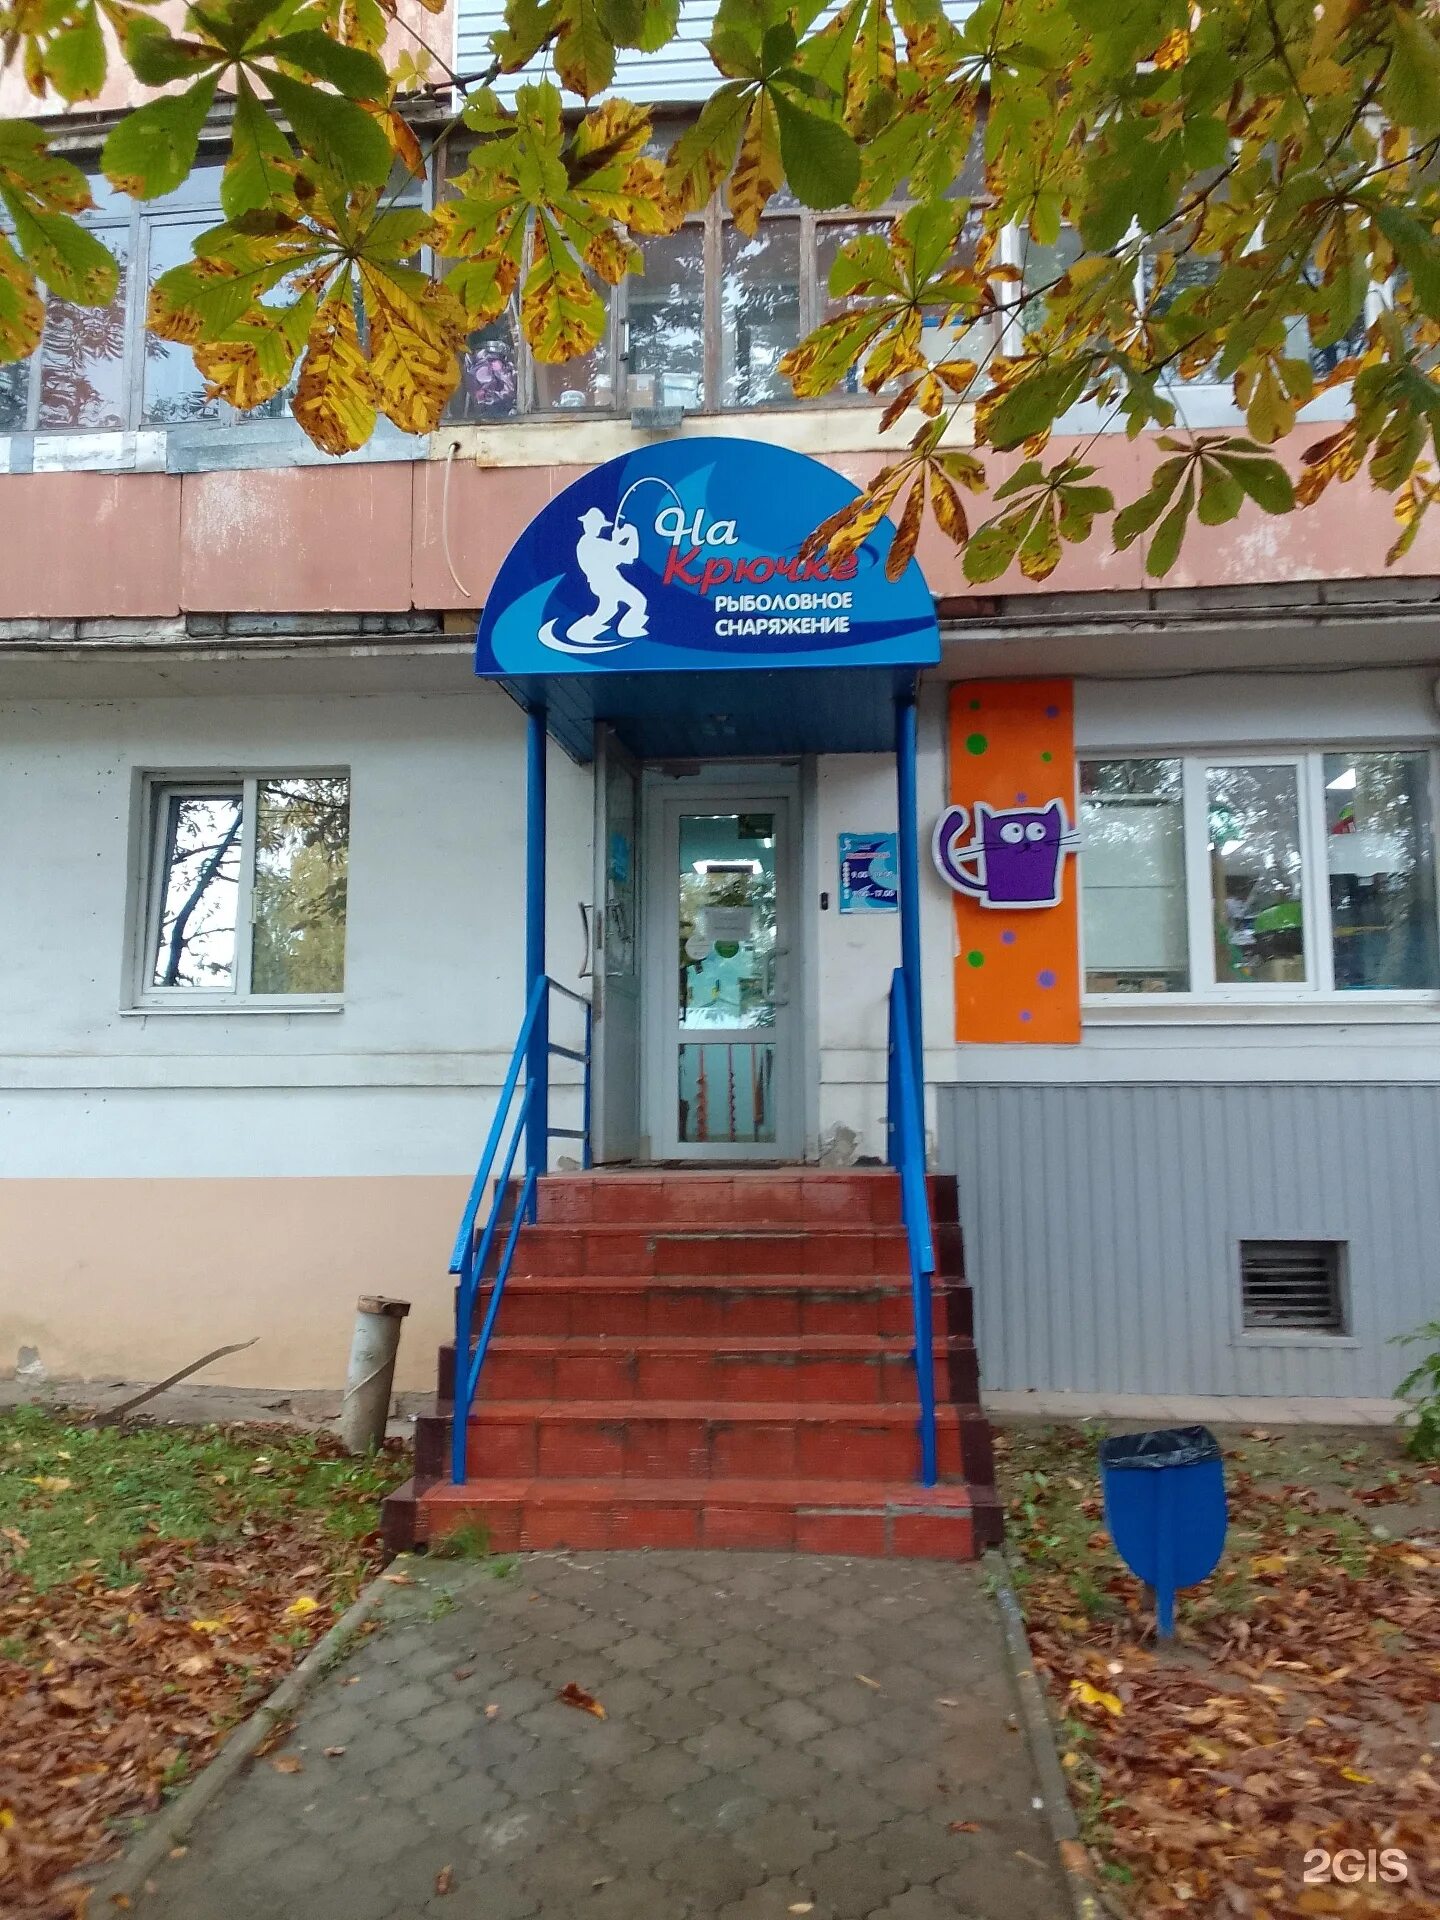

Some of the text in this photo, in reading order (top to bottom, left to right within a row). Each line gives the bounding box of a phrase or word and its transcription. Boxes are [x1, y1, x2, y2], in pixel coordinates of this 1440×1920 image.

[654, 507, 739, 546] На
[662, 545, 859, 595] Крючке
[714, 591, 853, 613] РЫБОЛОВНОЕ
[714, 616, 851, 637] СНАРЯЖЕНИЕ
